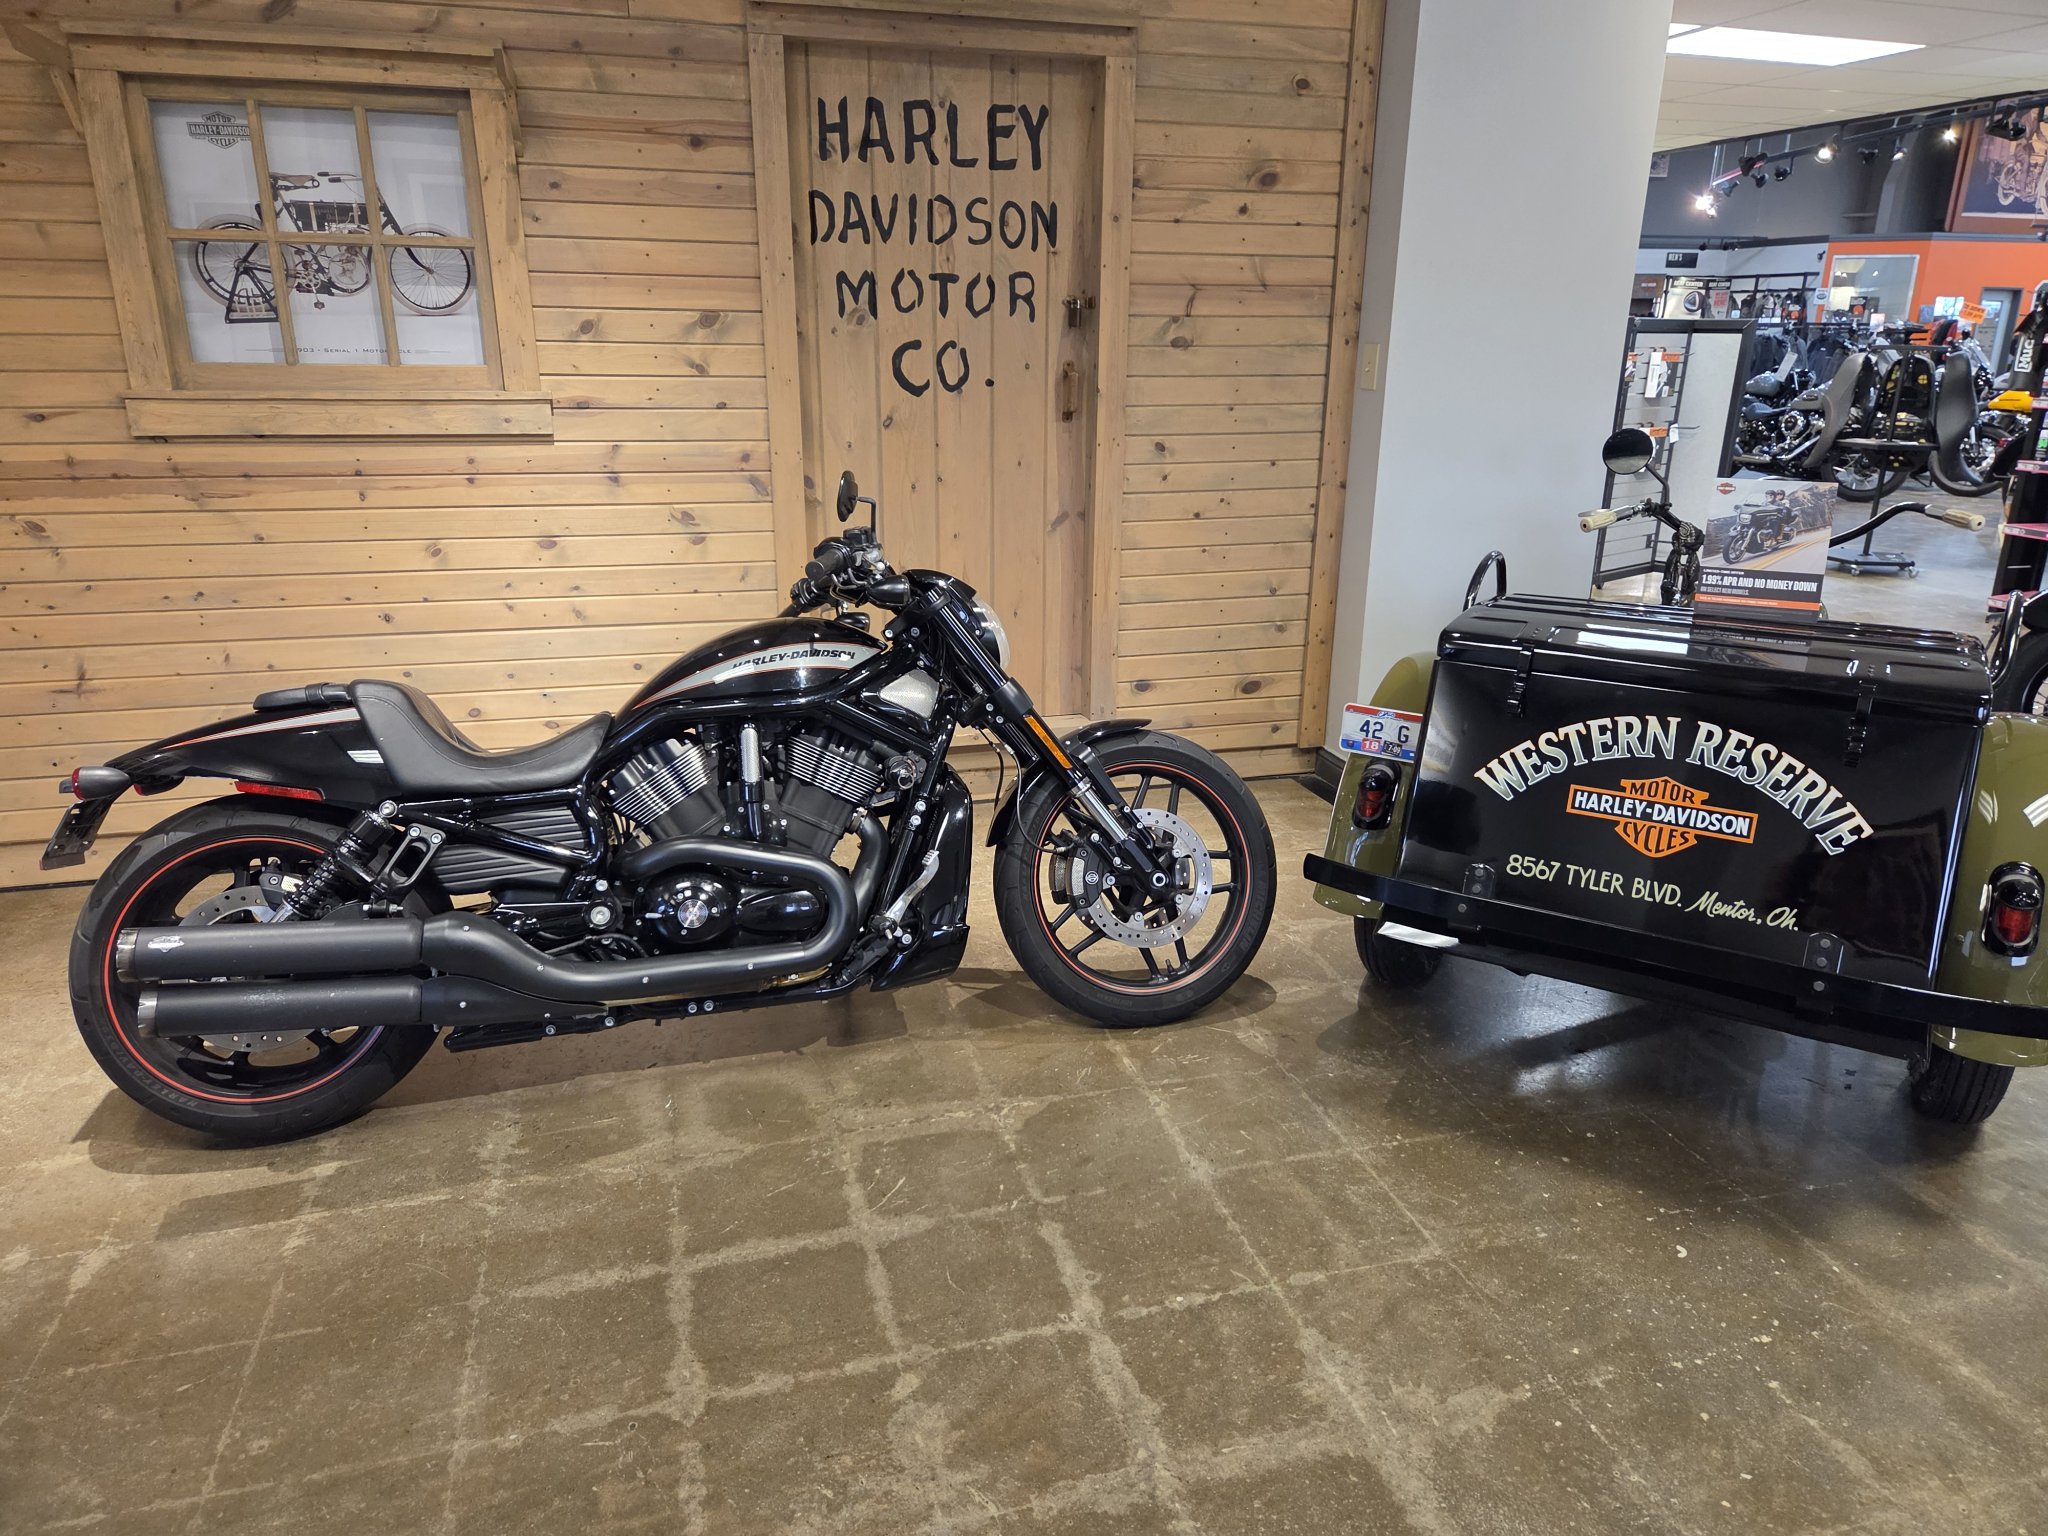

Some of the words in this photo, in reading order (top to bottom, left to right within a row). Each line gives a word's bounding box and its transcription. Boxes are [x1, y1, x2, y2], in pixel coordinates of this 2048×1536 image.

[205, 113, 232, 123] MOTOR
[818, 96, 1049, 170] HARLEY
[808, 190, 1057, 252] DAVIDSON
[836, 267, 1036, 322] MOTOR
[892, 339, 994, 397] CO.
[1722, 576, 1737, 587] APR
[1738, 577, 1754, 588] AND
[1754, 578, 1766, 589] NO
[1766, 579, 1793, 591] MONEY
[1360, 719, 1384, 740] 42
[1397, 725, 1410, 744] G
[1363, 741, 1379, 750] 18
[1474, 715, 1681, 802] WESTERN
[1685, 720, 1874, 856] RESERVE
[1629, 778, 1695, 805] MOTOR
[1574, 791, 1750, 836] HARLEY-DAVIDSON
[1622, 821, 1690, 854] CYCLES
[1506, 854, 1561, 882] 8567
[1566, 864, 1624, 896] TYLER
[1631, 877, 1682, 907] BLVD.
[1685, 890, 1762, 925] Mentor,
[1766, 906, 1799, 931] Oh.
